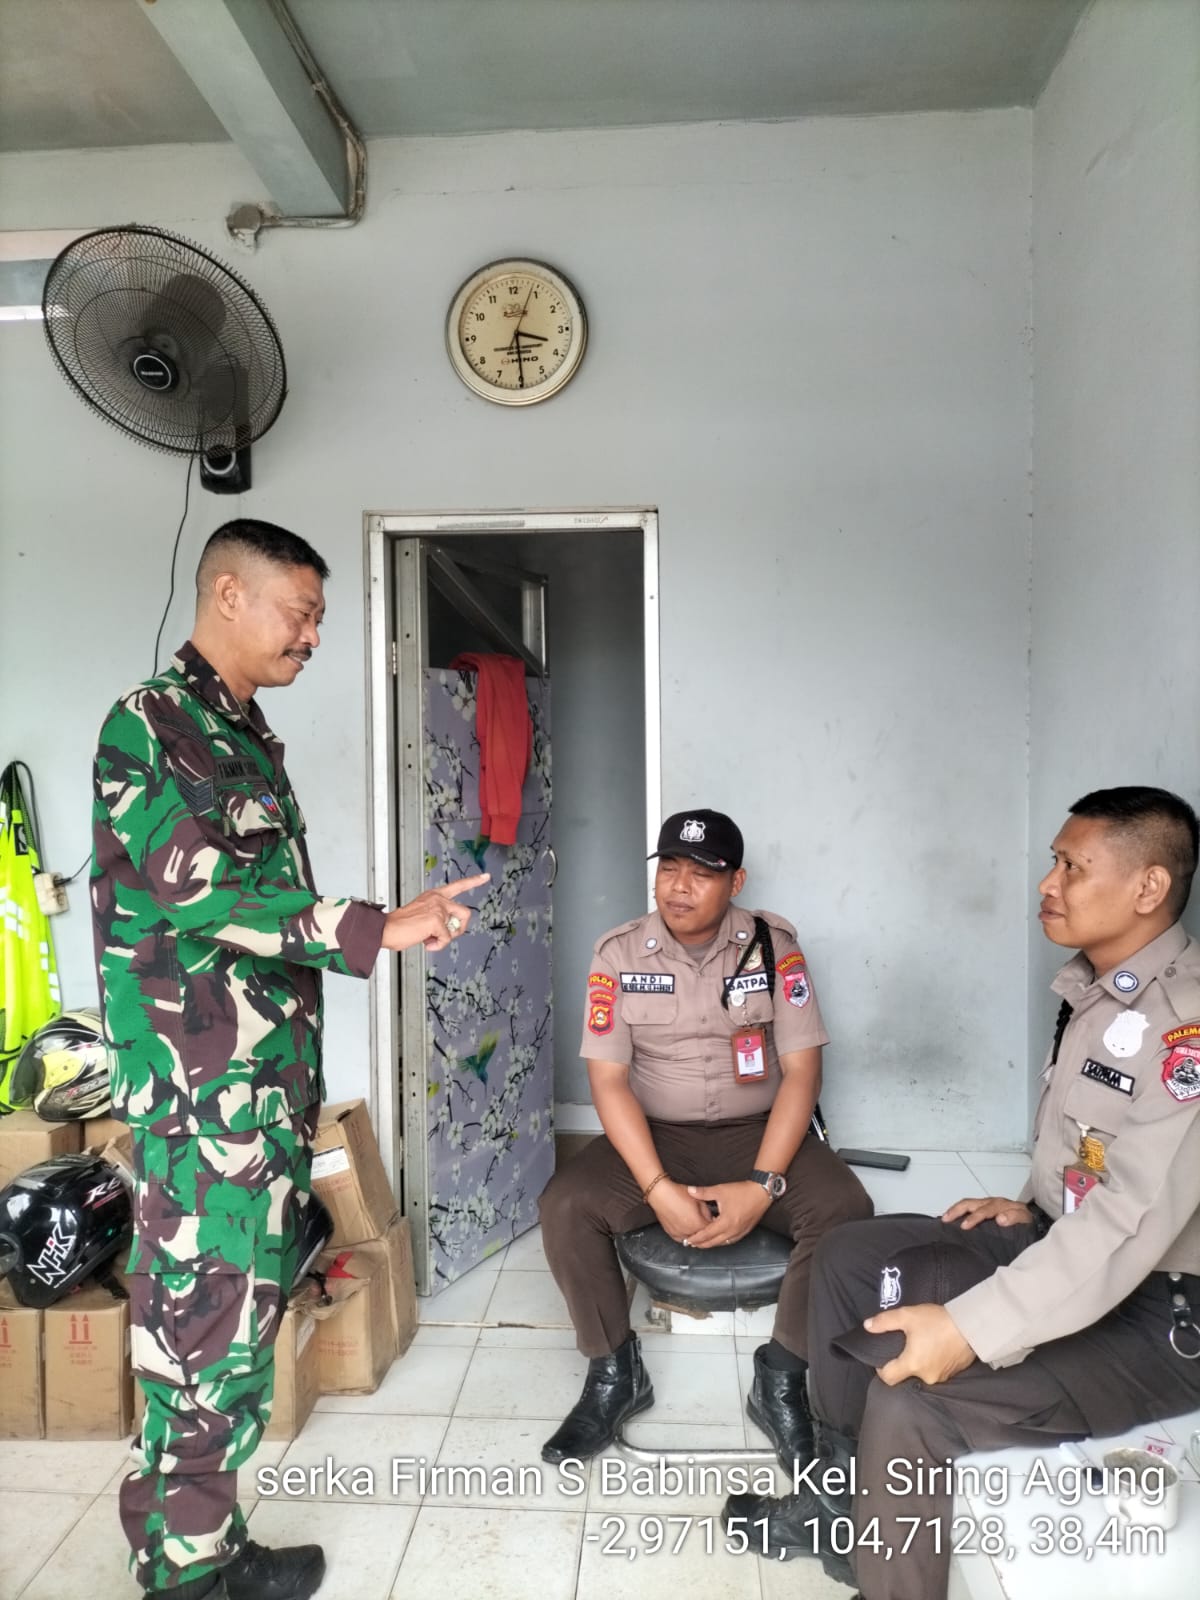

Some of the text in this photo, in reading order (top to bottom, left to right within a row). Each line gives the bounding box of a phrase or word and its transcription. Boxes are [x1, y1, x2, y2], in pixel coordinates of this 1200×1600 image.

[509, 286, 519, 295] 12
[533, 290, 538, 299] 1
[489, 295, 497, 304] 11
[550, 305, 556, 313] 2
[475, 313, 485, 321] 10
[558, 325, 564, 334] 3
[470, 335, 477, 344] 9
[553, 348, 559, 356] 4
[480, 356, 486, 364] 8
[511, 356, 539, 364] HNO
[539, 365, 545, 373] 5
[497, 370, 502, 379] 7
[631, 975, 662, 984] ANDI
[728, 976, 767, 991] ATPA
[1167, 1026, 1200, 1043] PALEM
[26, 1222, 77, 1286] NHK
